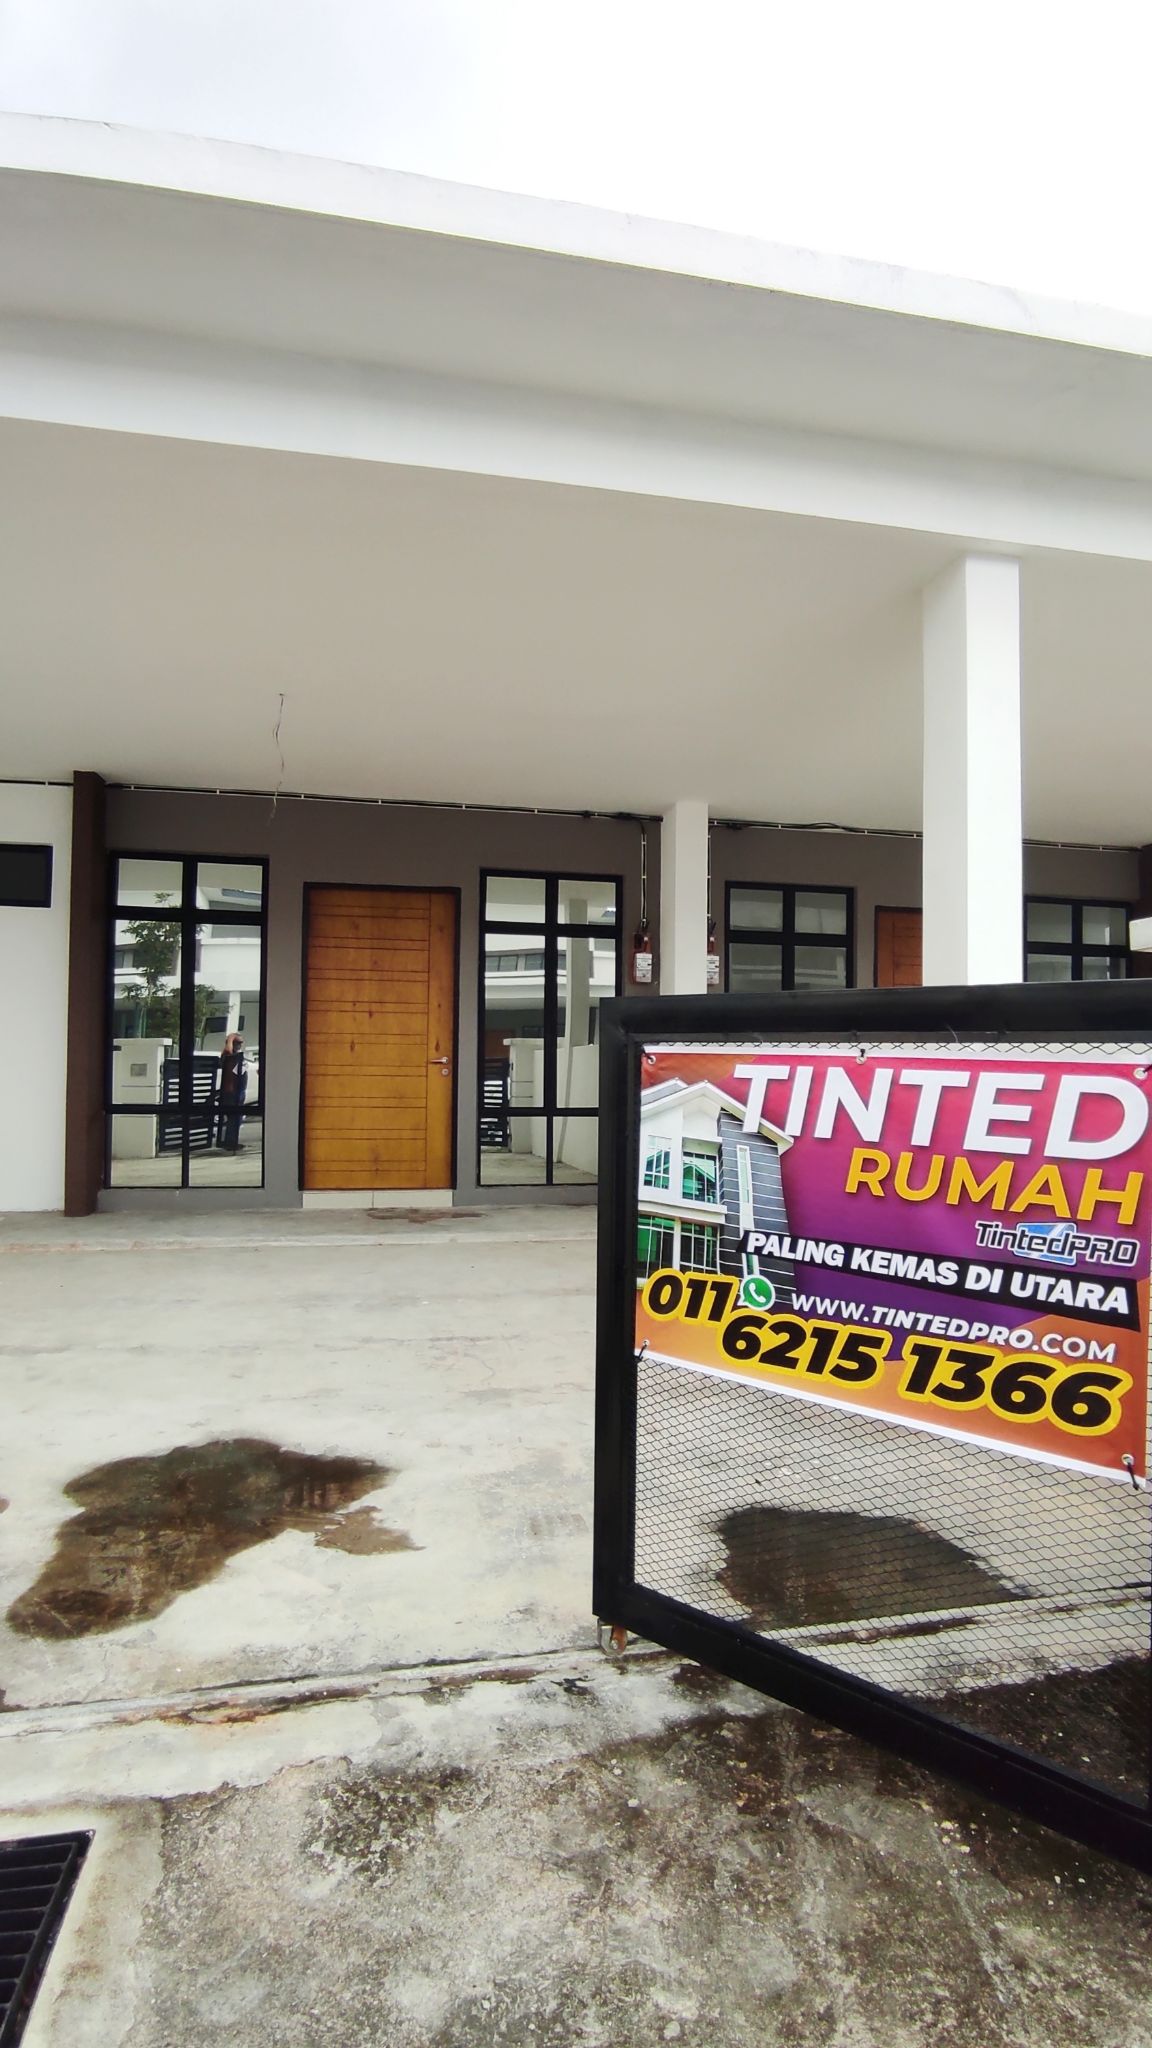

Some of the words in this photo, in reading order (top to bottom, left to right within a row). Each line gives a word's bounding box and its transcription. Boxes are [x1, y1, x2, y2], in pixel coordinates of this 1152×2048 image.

[733, 1064, 1150, 1160] TINTED
[844, 1147, 1143, 1225] RUMAH
[646, 1273, 734, 1323] 011
[747, 1231, 845, 1267] PALING
[851, 1249, 959, 1286] KEMAS
[965, 1267, 1000, 1293] DI
[1010, 1273, 1129, 1315] UTARA
[791, 1293, 1117, 1363] WWW.TINTEDPRO.COM
[721, 1319, 885, 1383] 6215
[904, 1342, 1124, 1429] 1366
